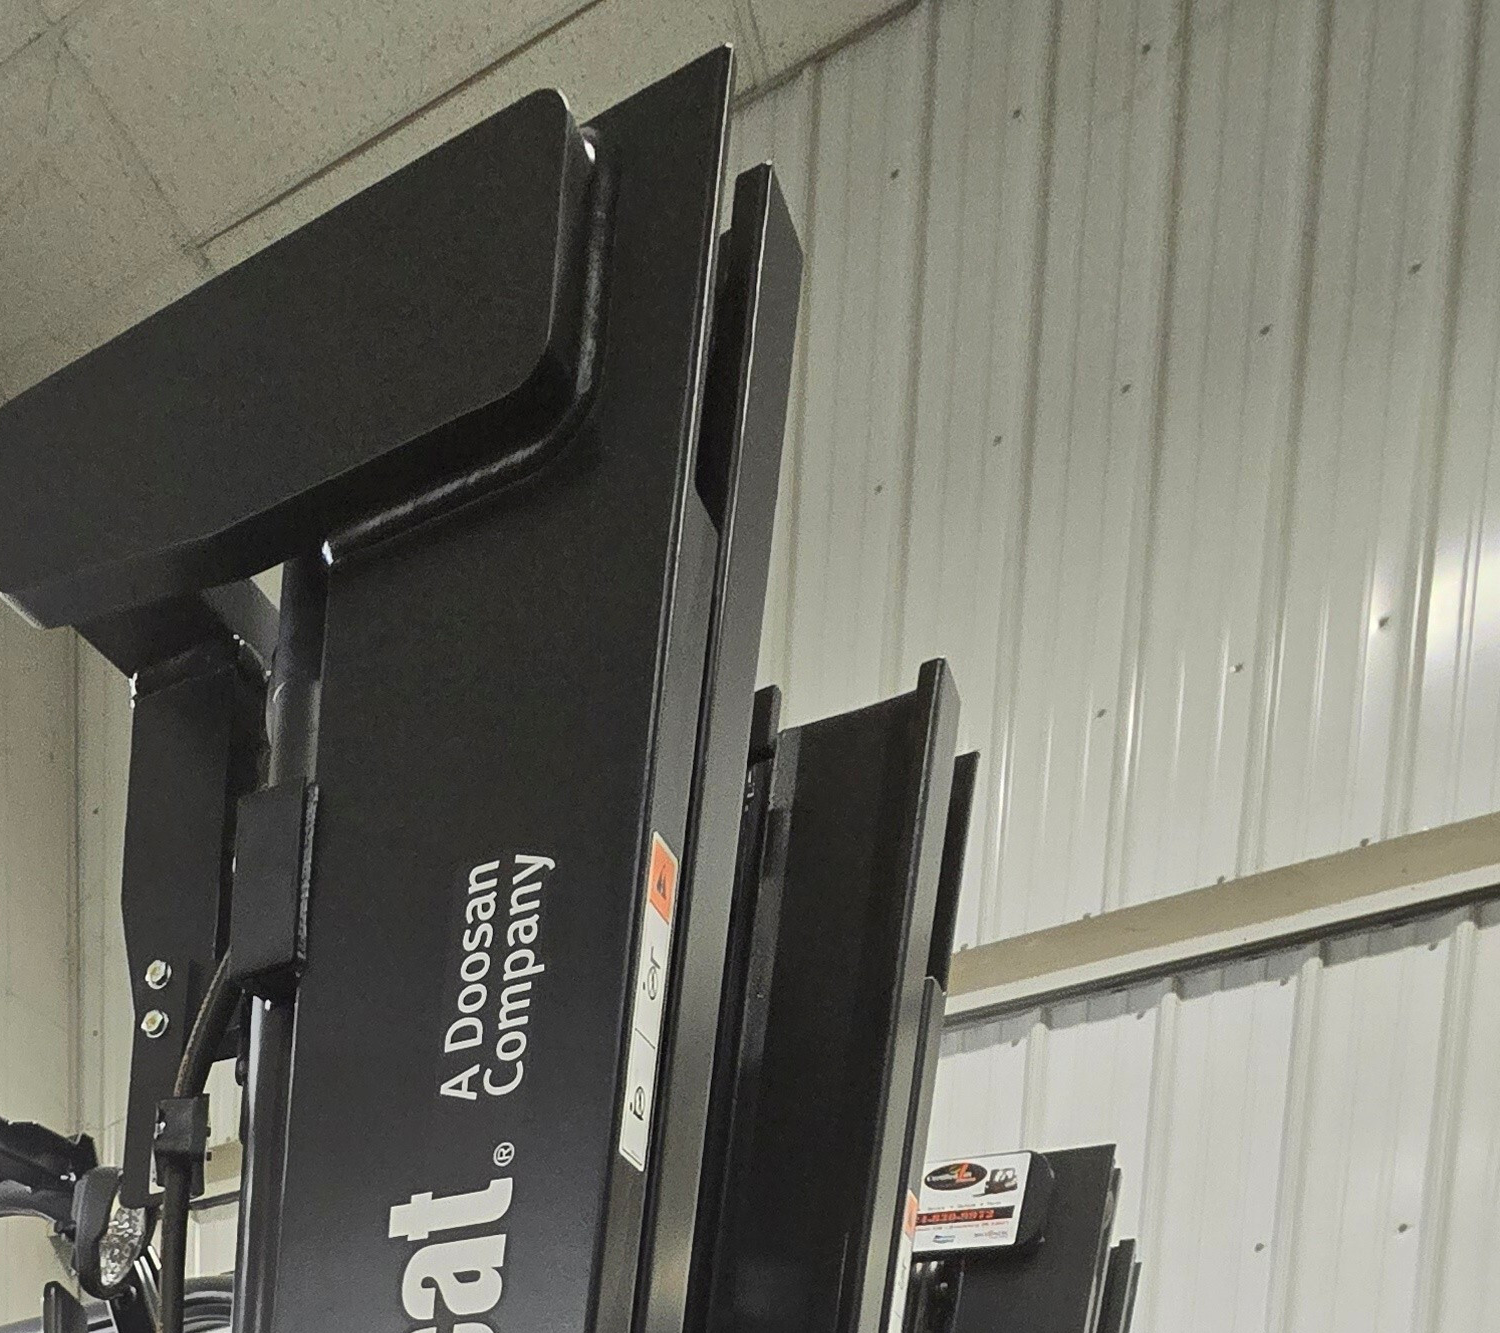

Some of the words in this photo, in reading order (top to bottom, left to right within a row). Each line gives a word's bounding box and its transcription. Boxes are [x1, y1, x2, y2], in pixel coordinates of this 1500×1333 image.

[444, 859, 501, 1054] Doosan
[483, 853, 556, 1097] Company
[440, 1063, 481, 1102] A
